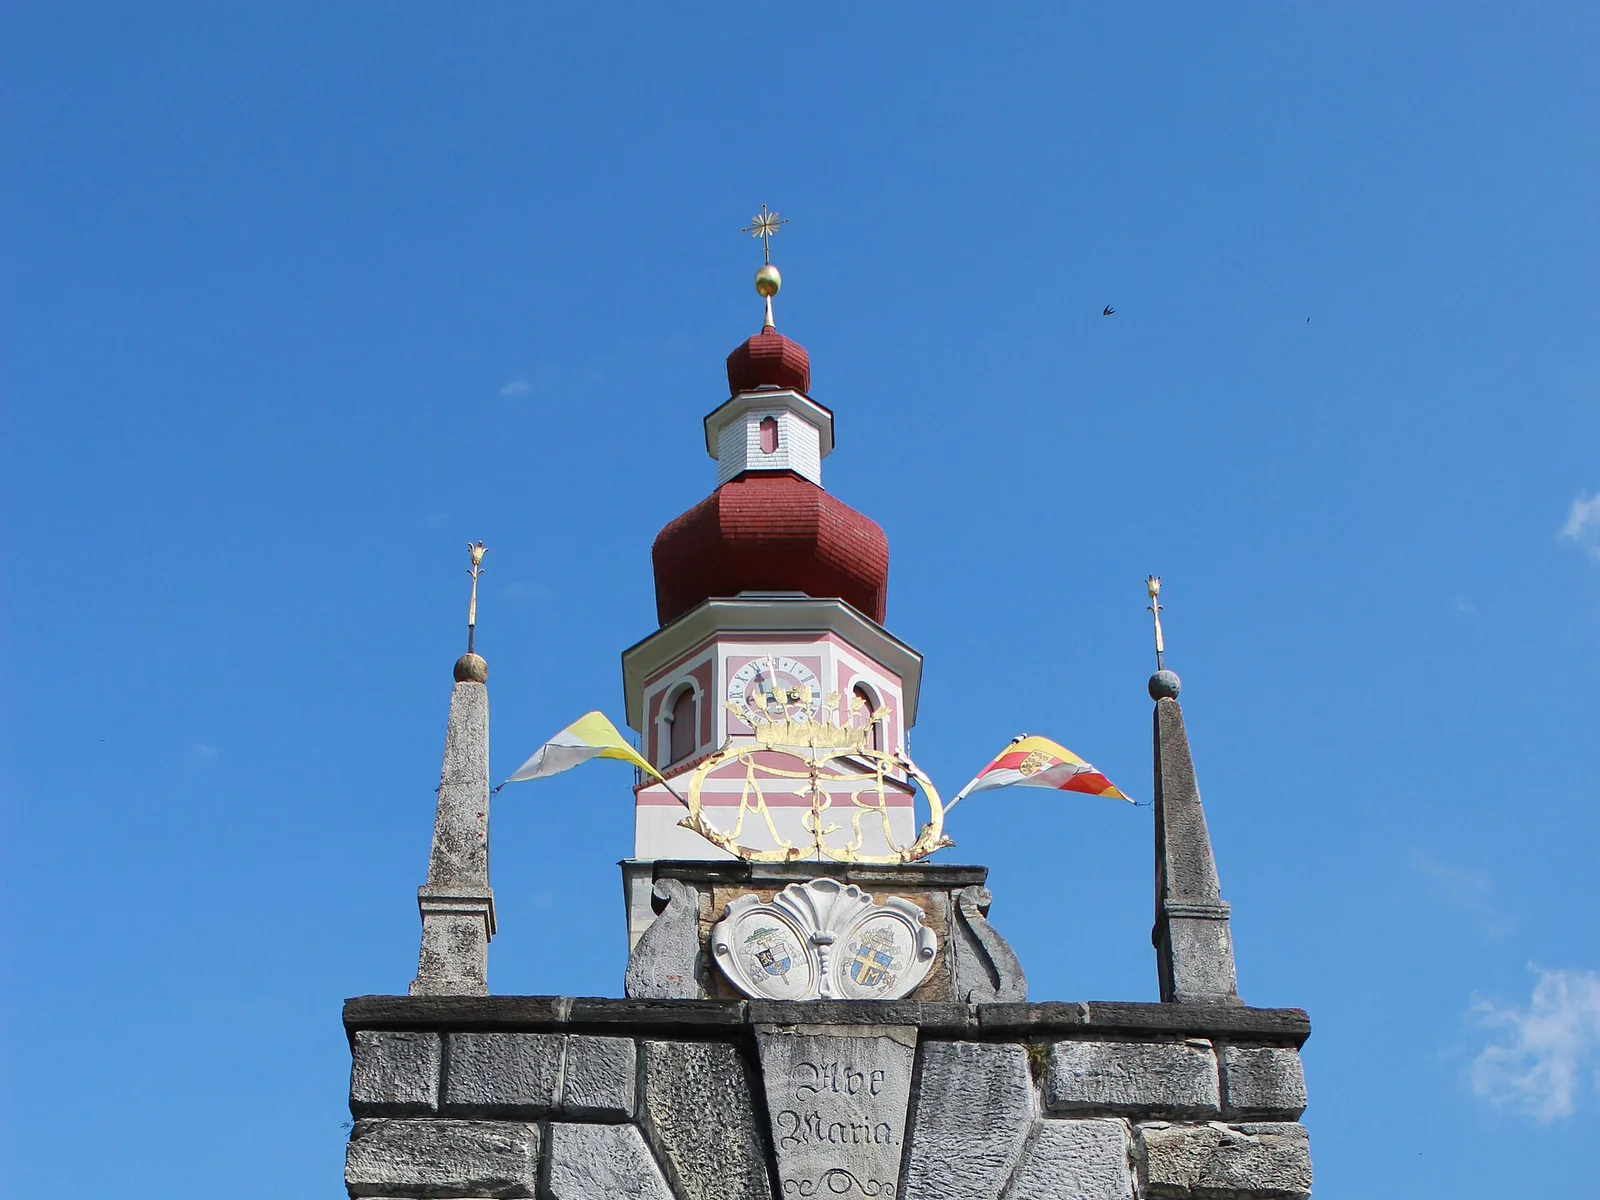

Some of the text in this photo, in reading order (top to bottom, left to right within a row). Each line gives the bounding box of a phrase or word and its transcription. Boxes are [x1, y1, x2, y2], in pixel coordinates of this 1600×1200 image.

[865, 969, 880, 985] M
[792, 1062, 885, 1101] Ave
[777, 1109, 900, 1150] Maria.
